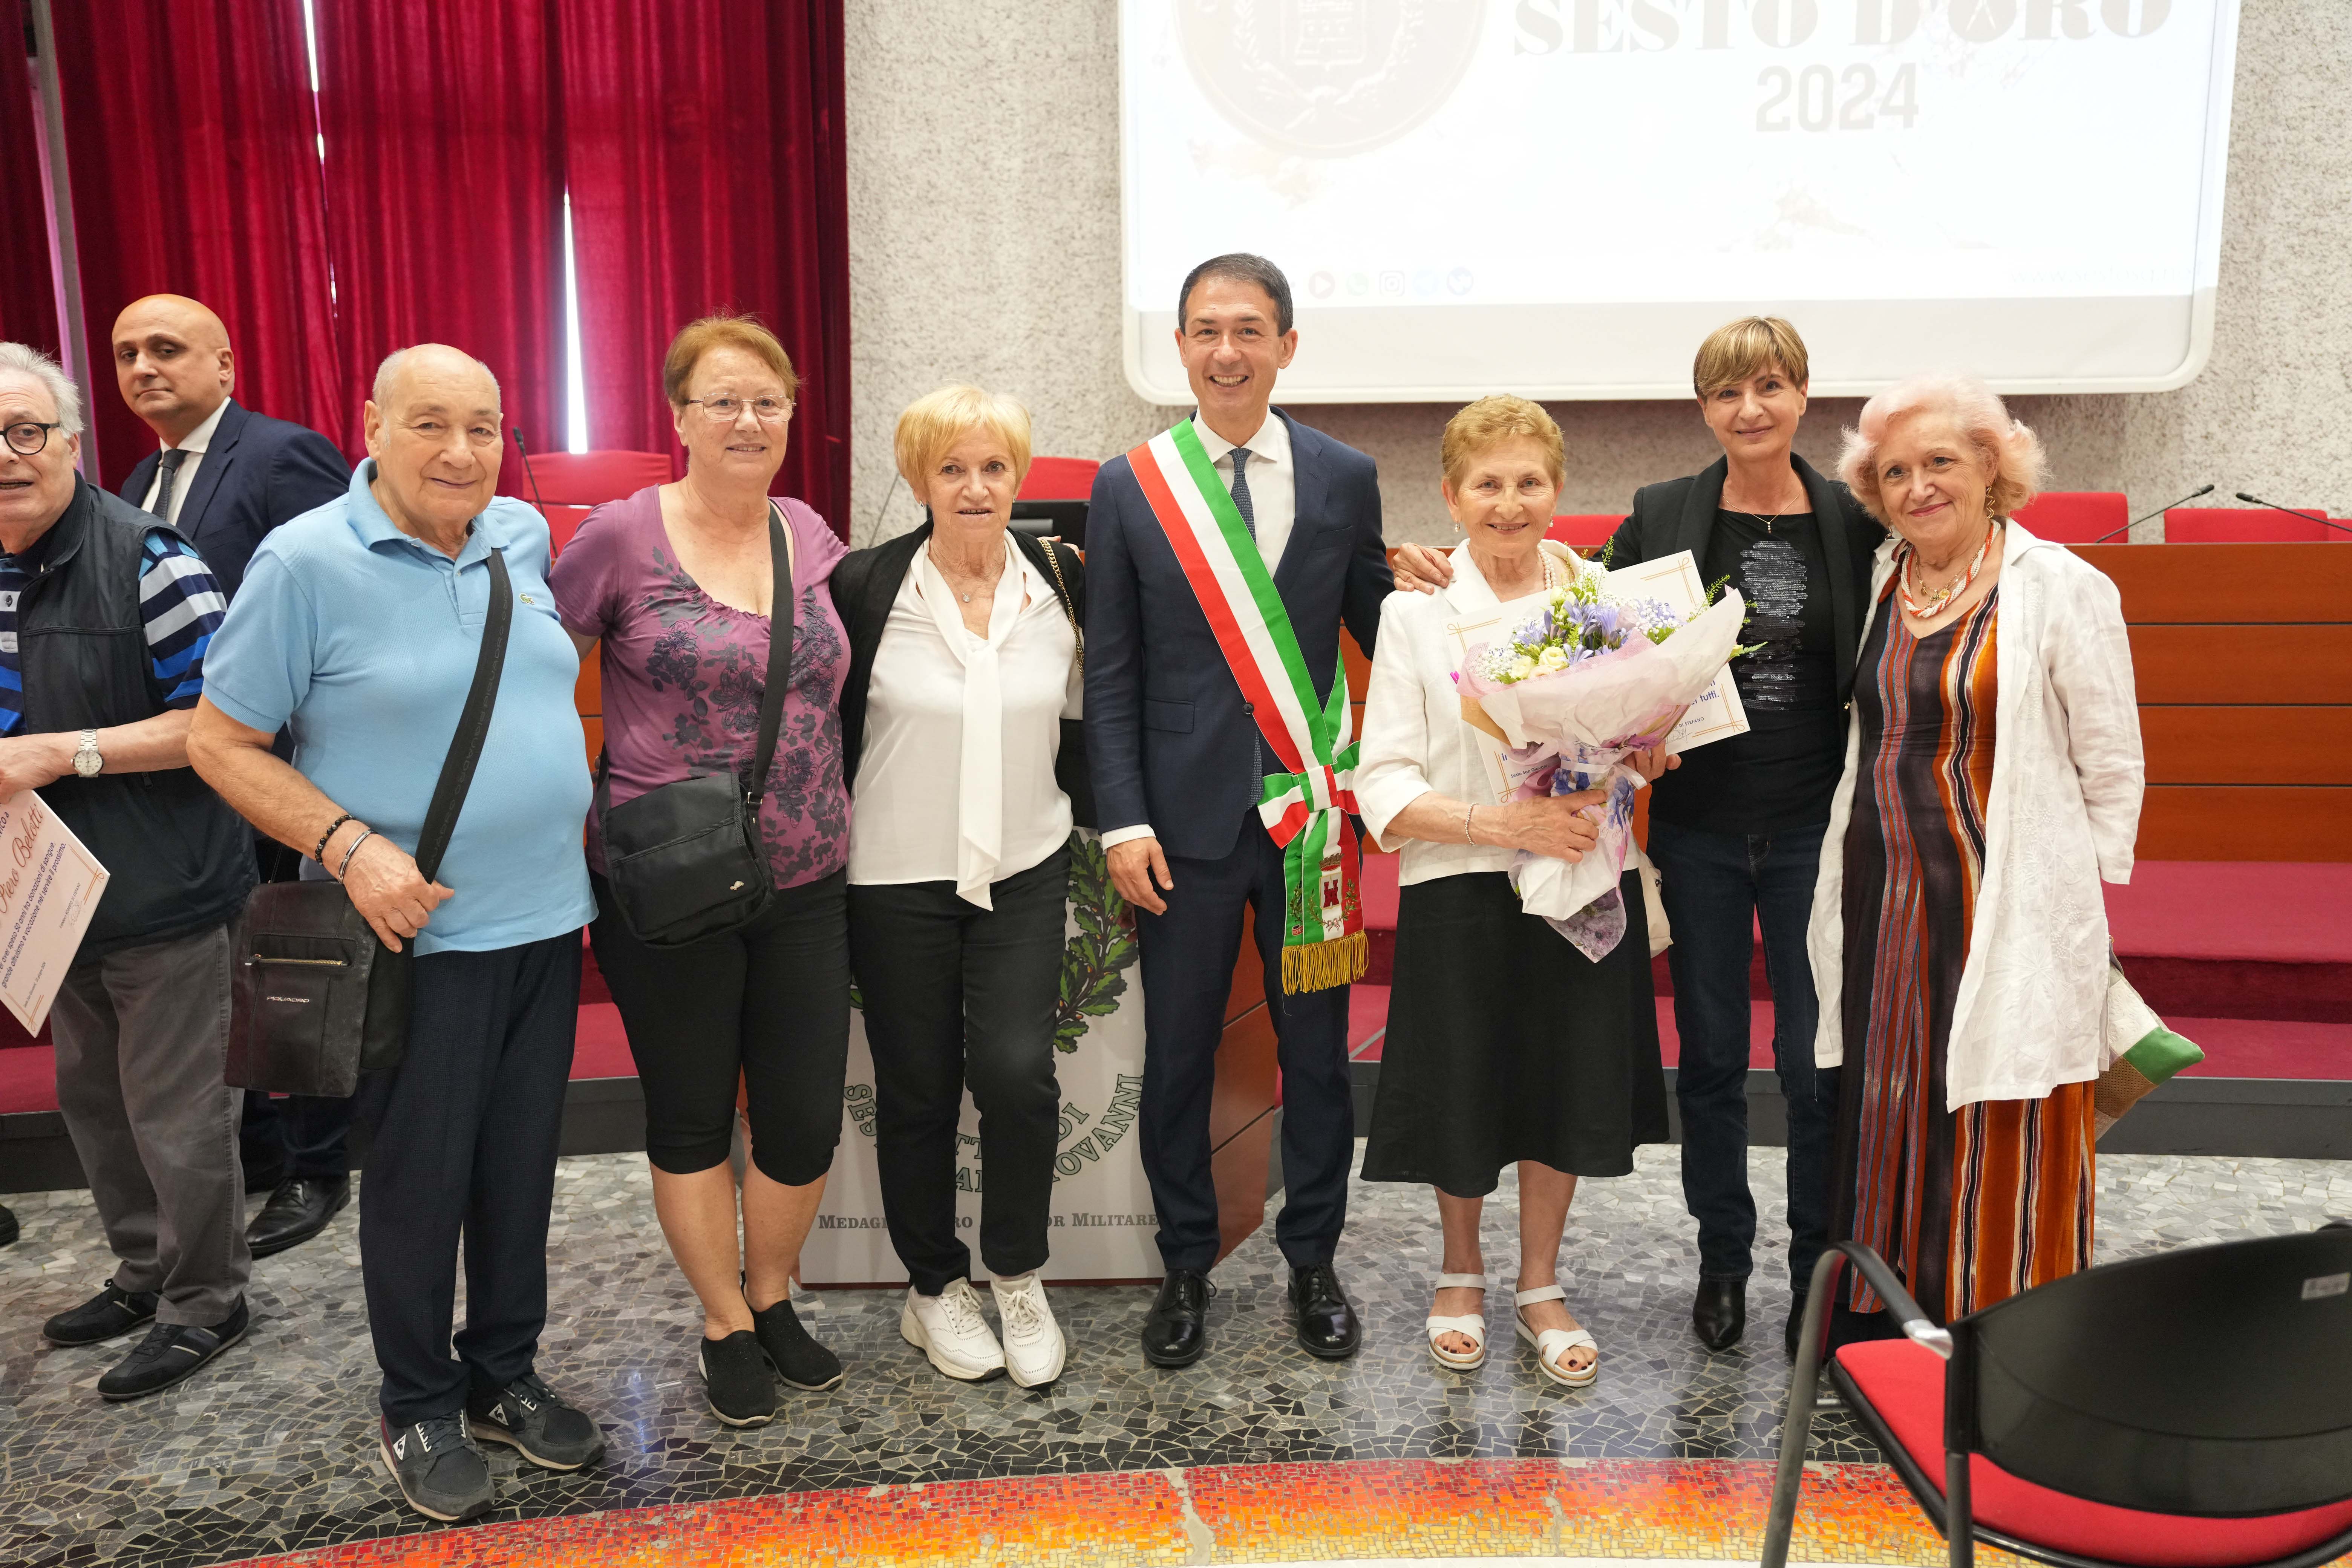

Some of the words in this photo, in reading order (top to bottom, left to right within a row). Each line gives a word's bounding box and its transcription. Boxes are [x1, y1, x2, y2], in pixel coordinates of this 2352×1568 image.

[1514, 0, 1818, 56] SESTO
[1849, 0, 2172, 46] D'ORO
[1756, 63, 1919, 132] 2024
[1685, 717, 1704, 726] STEFANO
[1700, 691, 1719, 702] tutti.
[12, 804, 43, 867] Belotti
[2, 967, 12, 989] grande
[11, 941, 24, 966] altruismo
[24, 905, 40, 935] vocazione
[42, 875, 52, 895] servire
[52, 844, 66, 871] prossimo.
[8, 932, 17, 949] speso
[15, 923, 21, 932] 50
[28, 871, 43, 901] donazioni
[40, 864, 46, 872] di
[844, 1084, 877, 1148] SES
[1052, 1074, 1144, 1182] OVANNI
[818, 1214, 888, 1229] MEDAG
[1072, 1213, 1159, 1227] MILITARE
